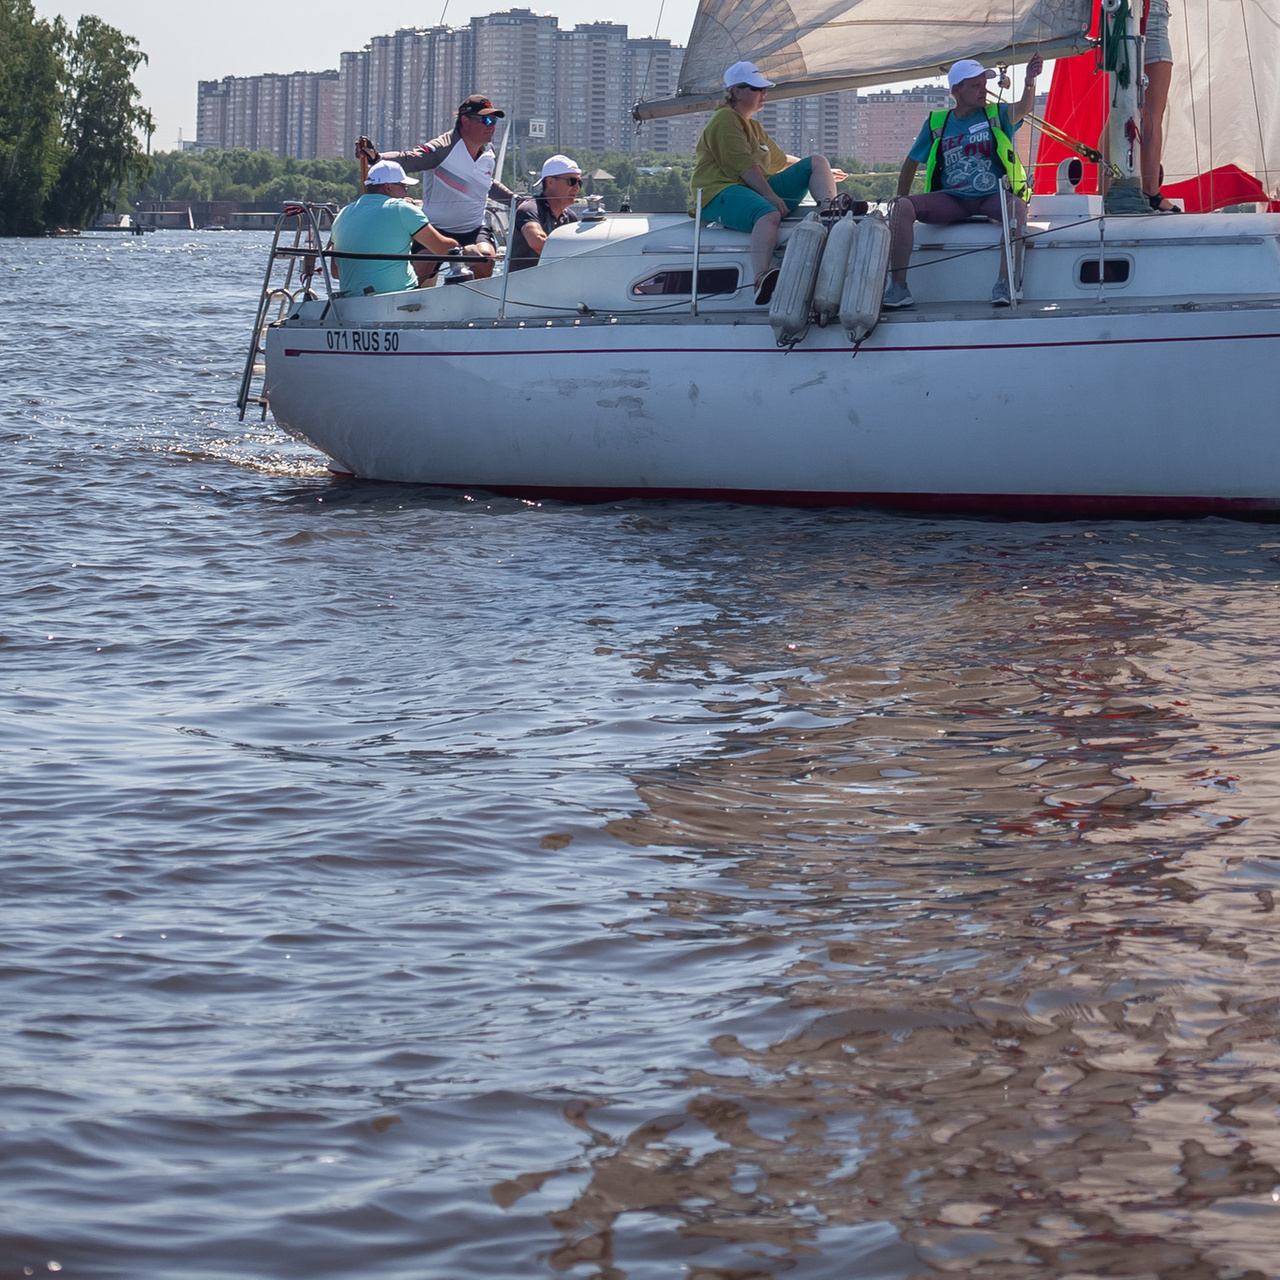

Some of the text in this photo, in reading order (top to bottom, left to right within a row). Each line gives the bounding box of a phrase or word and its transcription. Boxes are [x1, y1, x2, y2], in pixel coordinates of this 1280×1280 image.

[326, 331, 399, 352] 071 RUS 50
